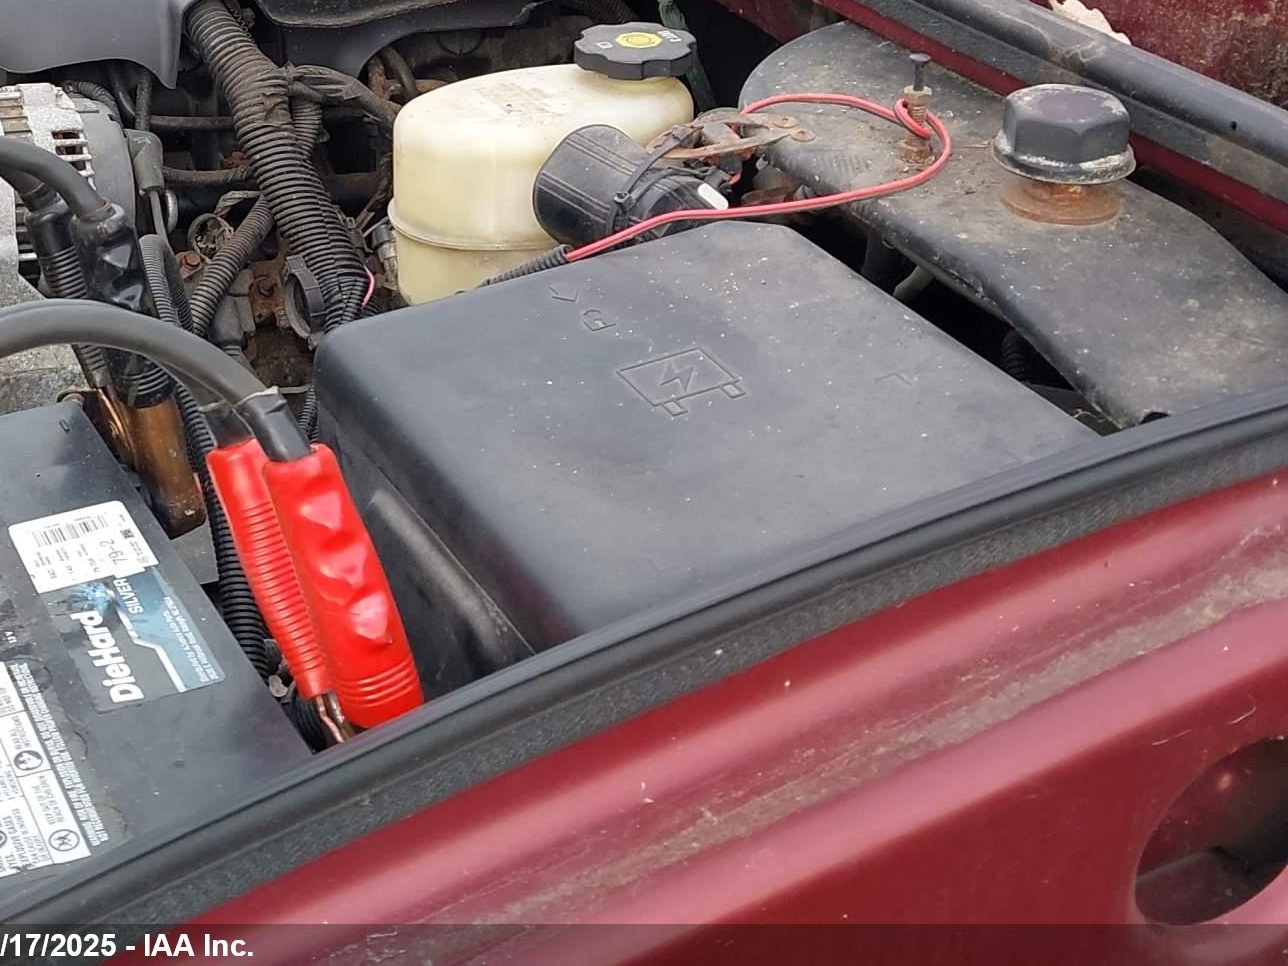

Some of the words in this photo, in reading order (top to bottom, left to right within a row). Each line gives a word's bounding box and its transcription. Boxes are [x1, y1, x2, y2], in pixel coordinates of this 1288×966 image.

[96, 539, 127, 566] 79-2
[113, 577, 144, 615] SILVER
[70, 610, 144, 703] DieHard
